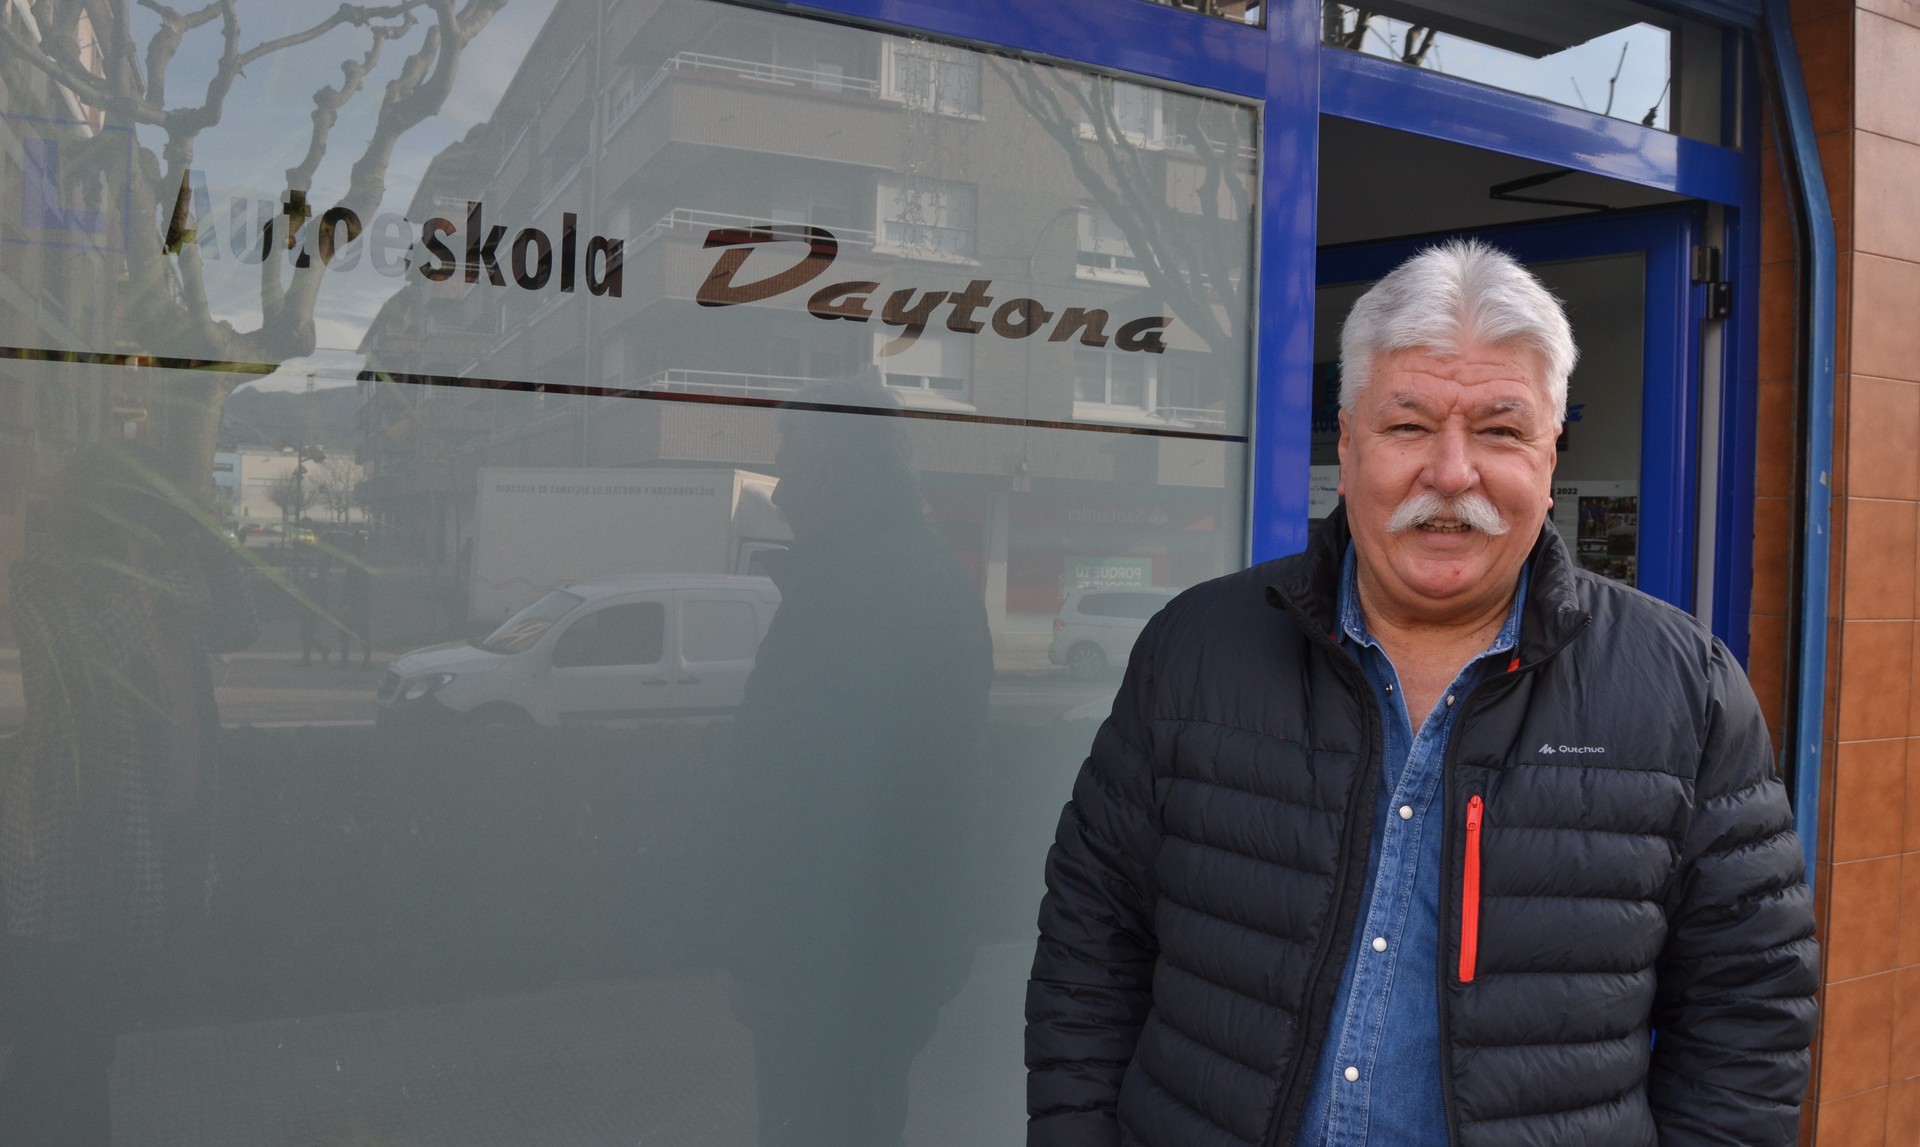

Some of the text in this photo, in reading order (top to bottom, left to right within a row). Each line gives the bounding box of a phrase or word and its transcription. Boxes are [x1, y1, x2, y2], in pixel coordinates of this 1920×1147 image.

[161, 168, 1174, 358] Autoeskola Daytona
[1556, 487, 1578, 495] 2022
[1558, 745, 1605, 754] Quechua
